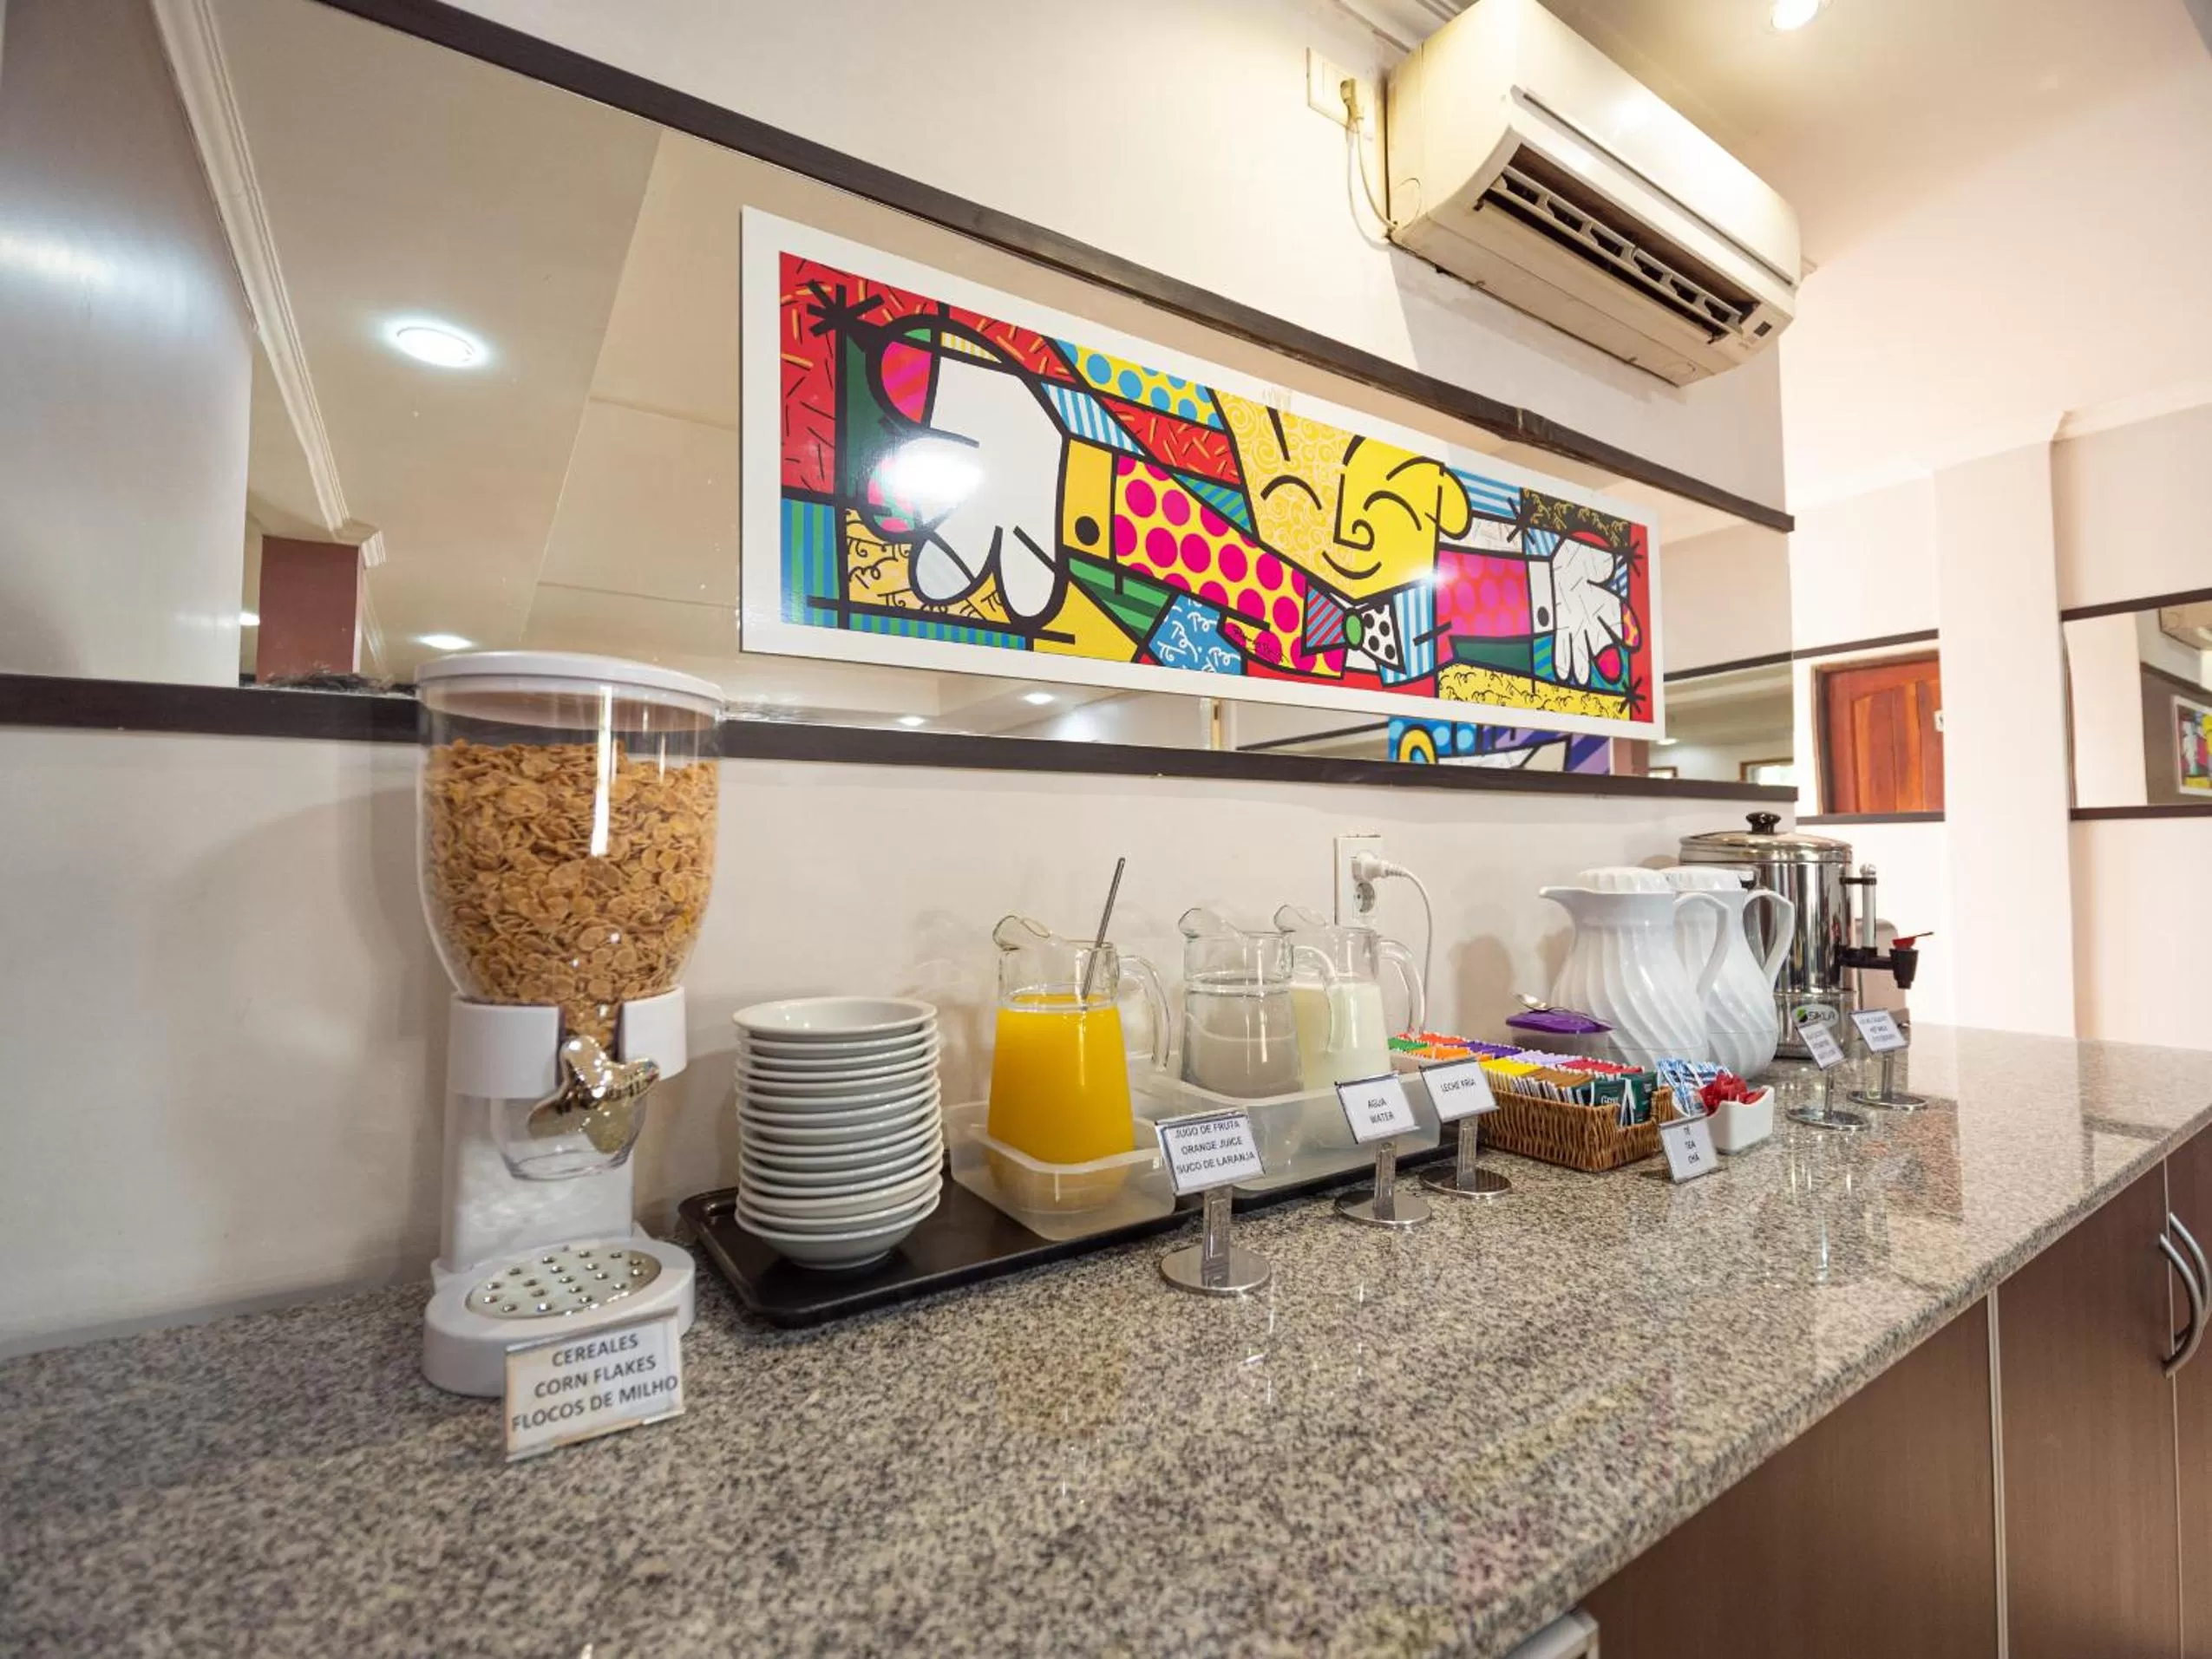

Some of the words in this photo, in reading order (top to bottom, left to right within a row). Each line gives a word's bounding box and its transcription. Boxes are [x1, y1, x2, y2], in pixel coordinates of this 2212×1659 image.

[1175, 1127, 1198, 1138] JUGO
[1201, 1125, 1213, 1134] DE
[1214, 1120, 1240, 1132] FRUTA
[1370, 1112, 1395, 1124] WATER
[1181, 1141, 1217, 1155] ORANGE
[1220, 1136, 1243, 1148] JUICE
[1176, 1162, 1202, 1174] SUCO
[1203, 1159, 1215, 1169] DE
[1216, 1151, 1255, 1166] LARANJA
[552, 1333, 639, 1368] CEREALES
[534, 1372, 588, 1399] CORN
[593, 1355, 657, 1384] FLAKES
[512, 1399, 585, 1433] FLOCOS
[590, 1392, 613, 1411] DE
[618, 1375, 678, 1405] MILHO
